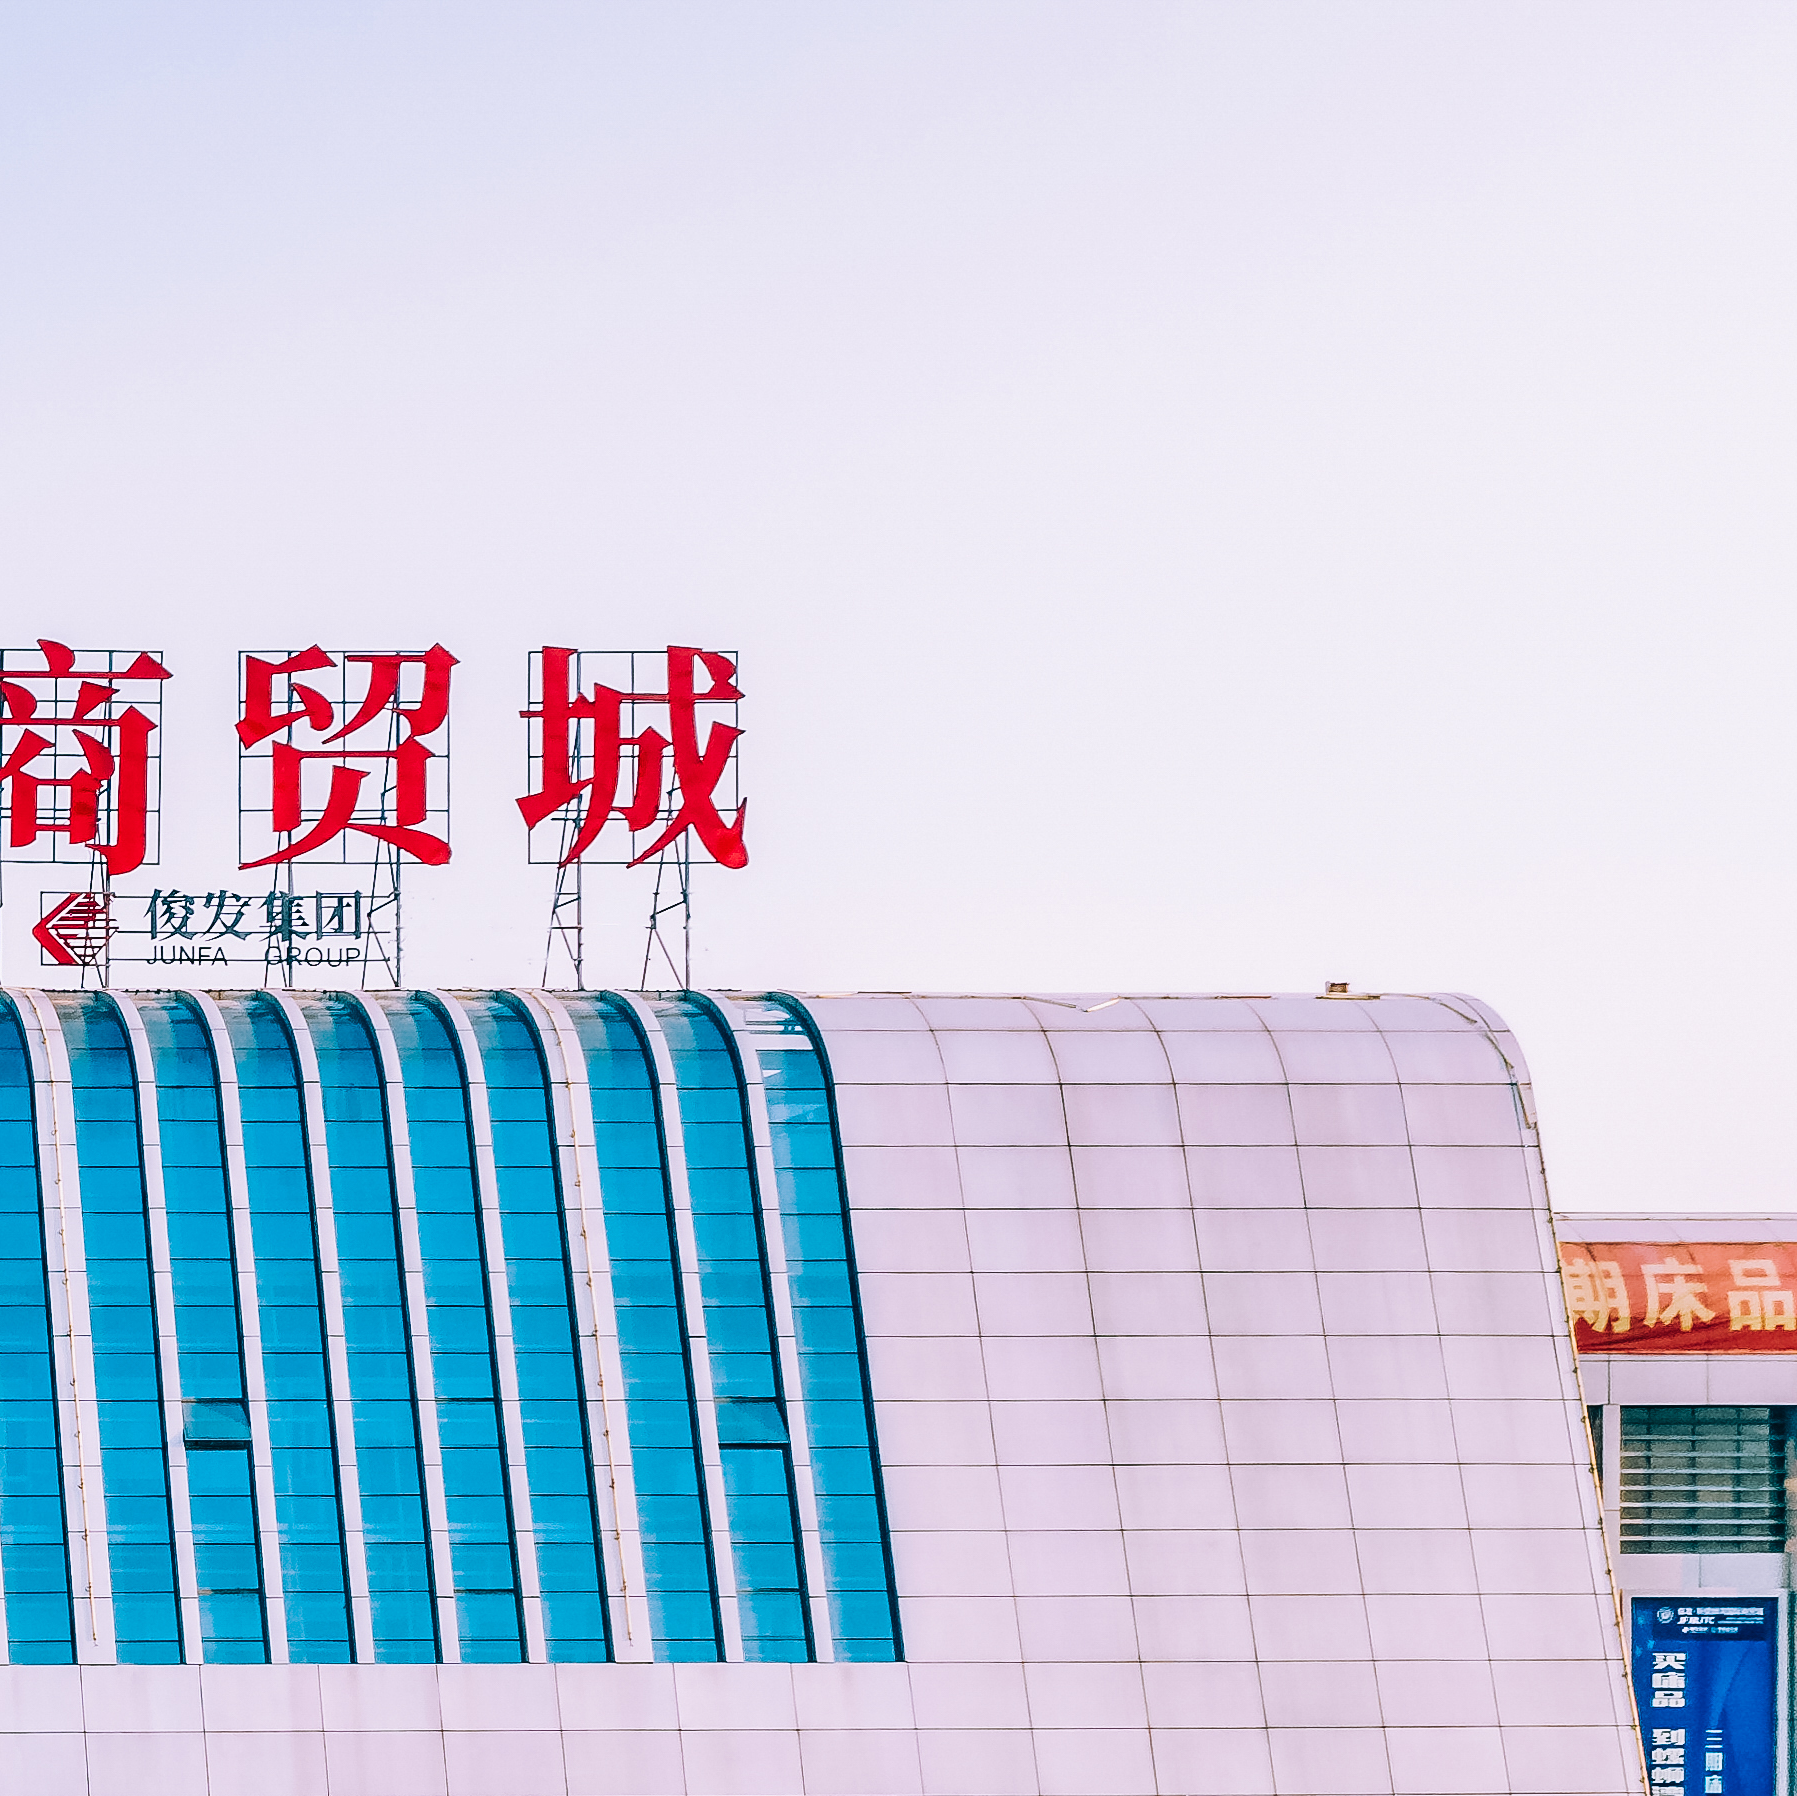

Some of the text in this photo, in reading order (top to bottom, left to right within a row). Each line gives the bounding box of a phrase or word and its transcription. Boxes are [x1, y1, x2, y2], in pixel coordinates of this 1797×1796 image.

[144, 888, 363, 942] 俊发集团
[146, 946, 362, 968] JUNFA GROUP
